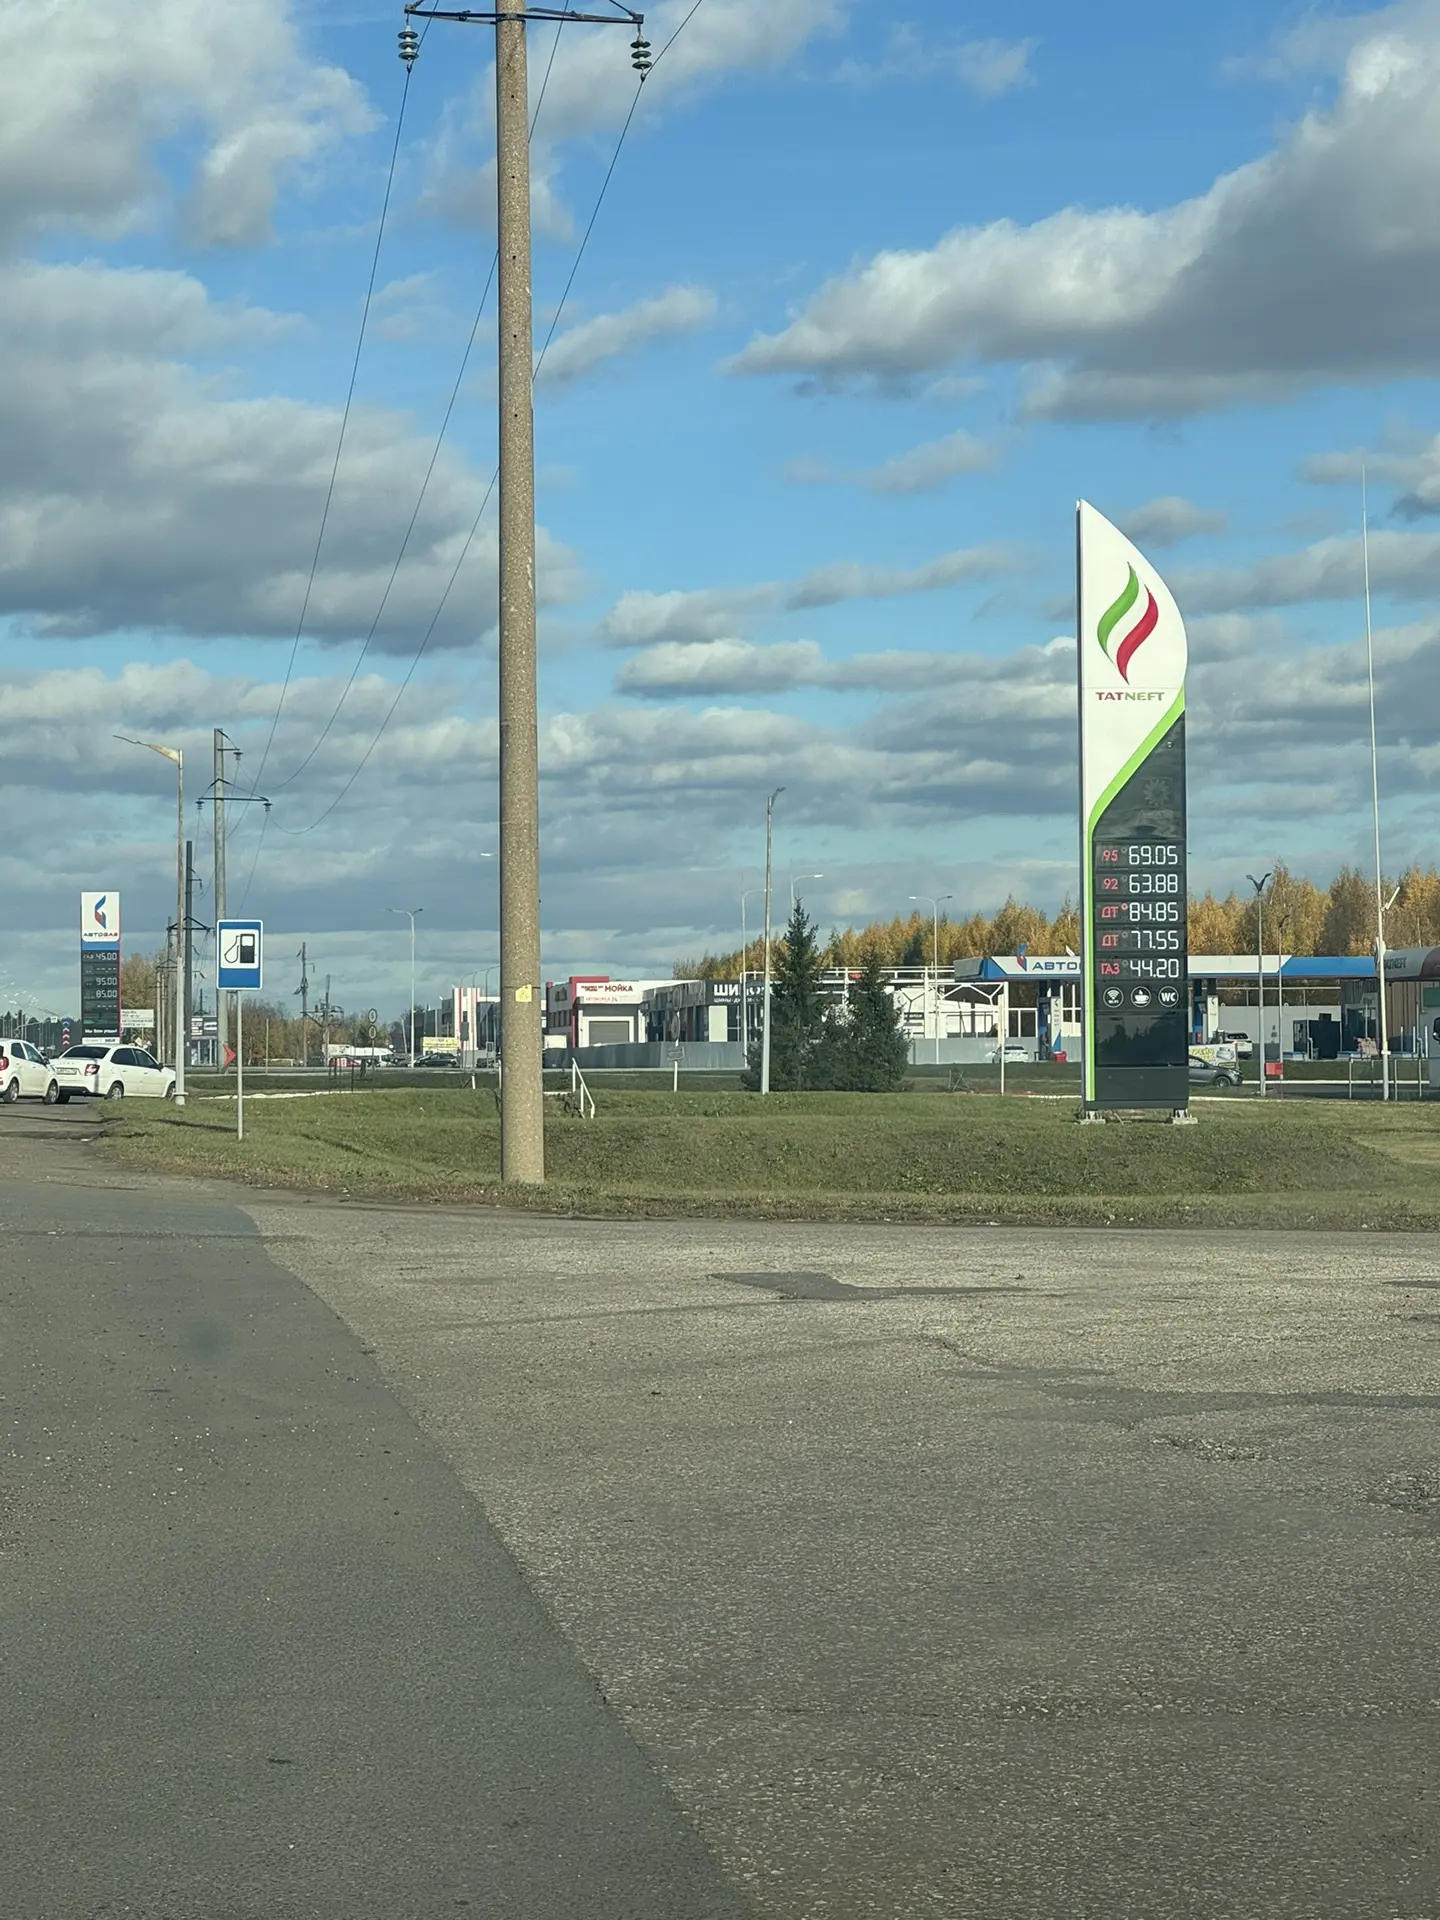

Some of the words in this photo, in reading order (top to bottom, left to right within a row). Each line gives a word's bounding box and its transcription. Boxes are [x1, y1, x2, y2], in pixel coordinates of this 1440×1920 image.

[1095, 691, 1165, 701] TATNEFT
[1103, 850, 1119, 861] 95
[1129, 846, 1179, 865] 69.05
[1103, 878, 1119, 890] 92
[1129, 874, 1179, 893] 63.88
[1101, 906, 1119, 918] ДТ
[1129, 902, 1179, 921] 84.85
[1101, 935, 1119, 946] ДТ
[1129, 930, 1179, 949] 77.55
[96, 952, 117, 961] 45.00
[1032, 962, 1081, 970] АВТО
[1100, 963, 1120, 975] ГАЗ
[1129, 958, 1179, 978] 44.20
[96, 977, 117, 986] 95.00
[605, 984, 633, 992] МОЙКА
[96, 989, 117, 998] 85.00
[1161, 992, 1176, 1002] WC
